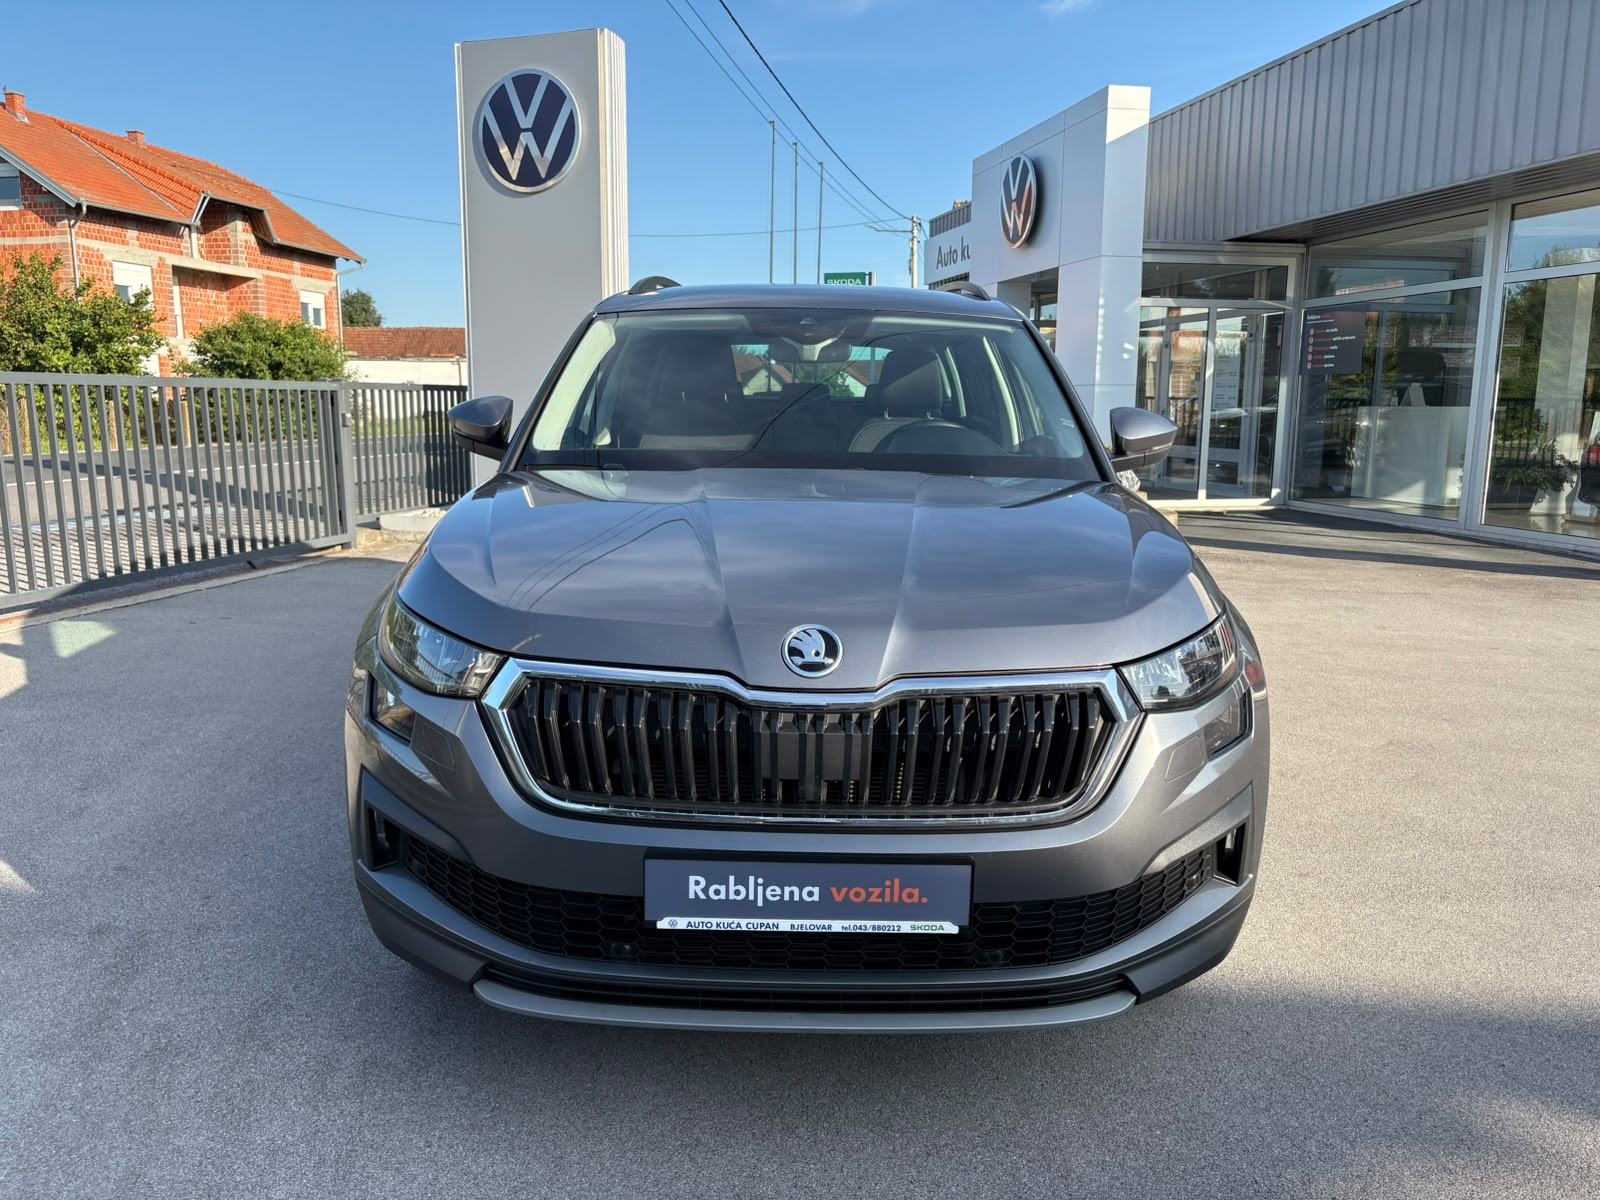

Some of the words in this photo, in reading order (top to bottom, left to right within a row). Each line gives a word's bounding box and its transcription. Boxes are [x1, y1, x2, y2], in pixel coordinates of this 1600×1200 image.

[936, 245, 958, 270] Auto
[688, 875, 820, 906] Rabljena
[829, 878, 928, 904] vozila.
[686, 920, 714, 929] AUTO
[715, 919, 743, 930] KUĆA
[745, 922, 779, 930] CUPAN
[790, 923, 833, 931] BJELOVAR
[841, 924, 901, 932] tel.043/880212
